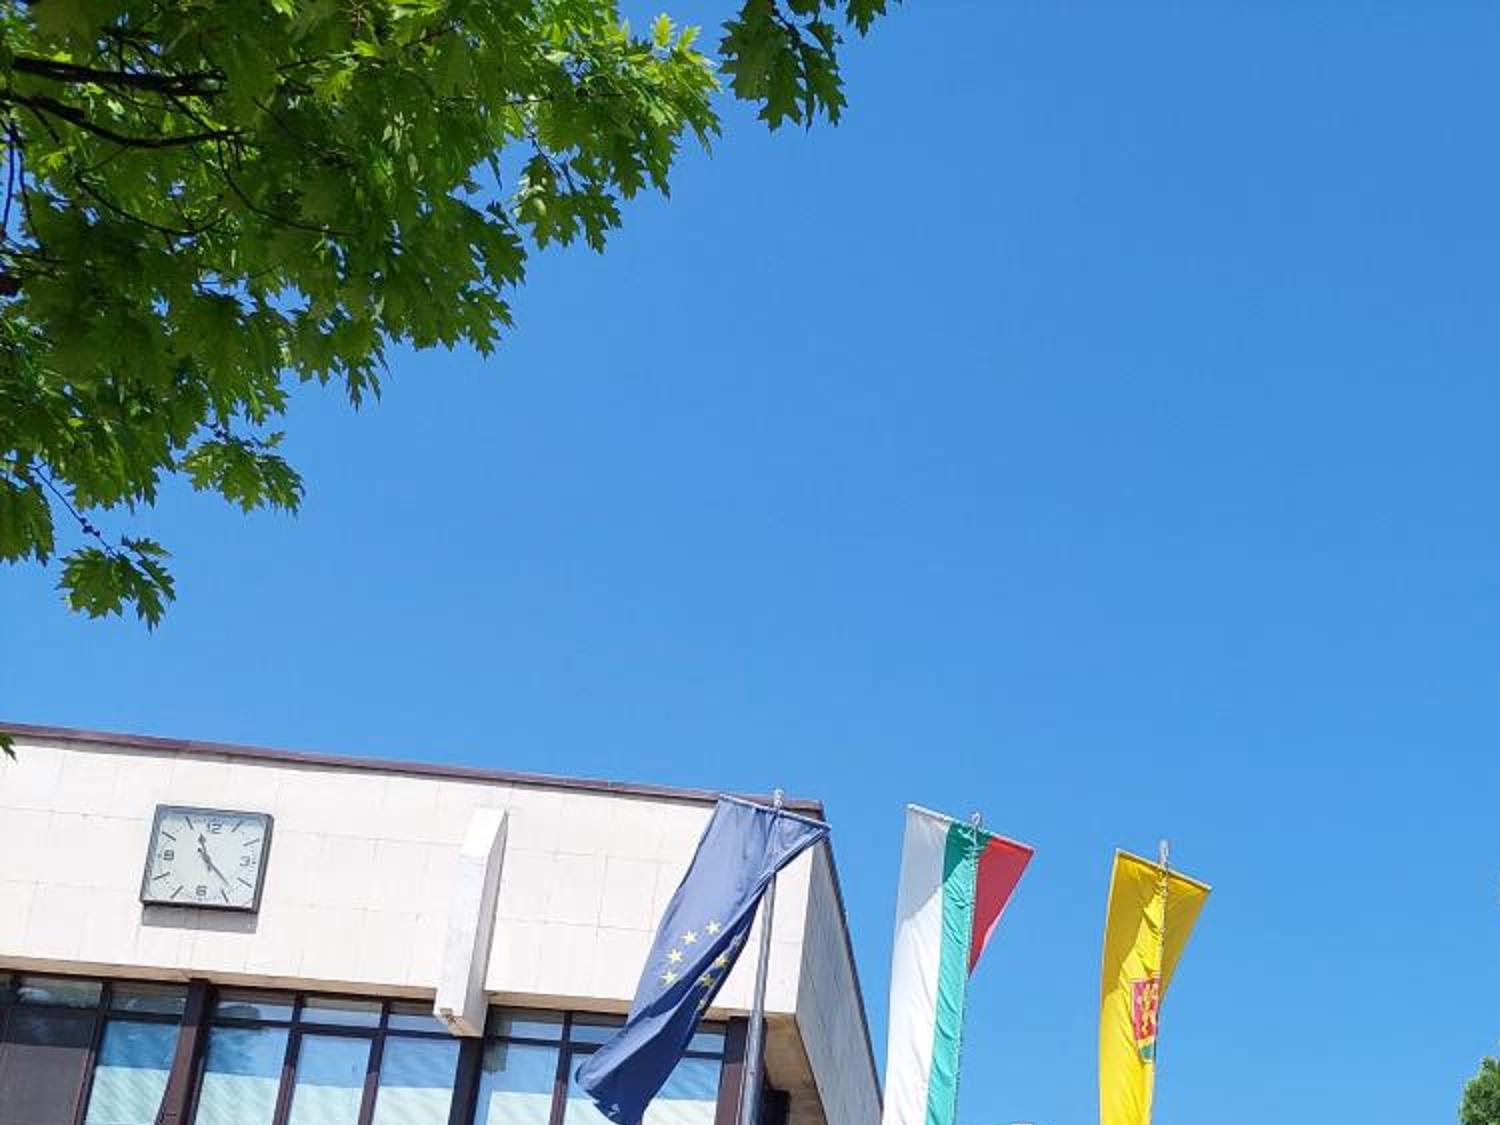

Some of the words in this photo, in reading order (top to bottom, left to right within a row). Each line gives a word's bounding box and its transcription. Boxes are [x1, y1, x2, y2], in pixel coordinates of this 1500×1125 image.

[207, 822, 222, 834] 12
[163, 850, 175, 861] 9
[195, 885, 207, 897] 6
